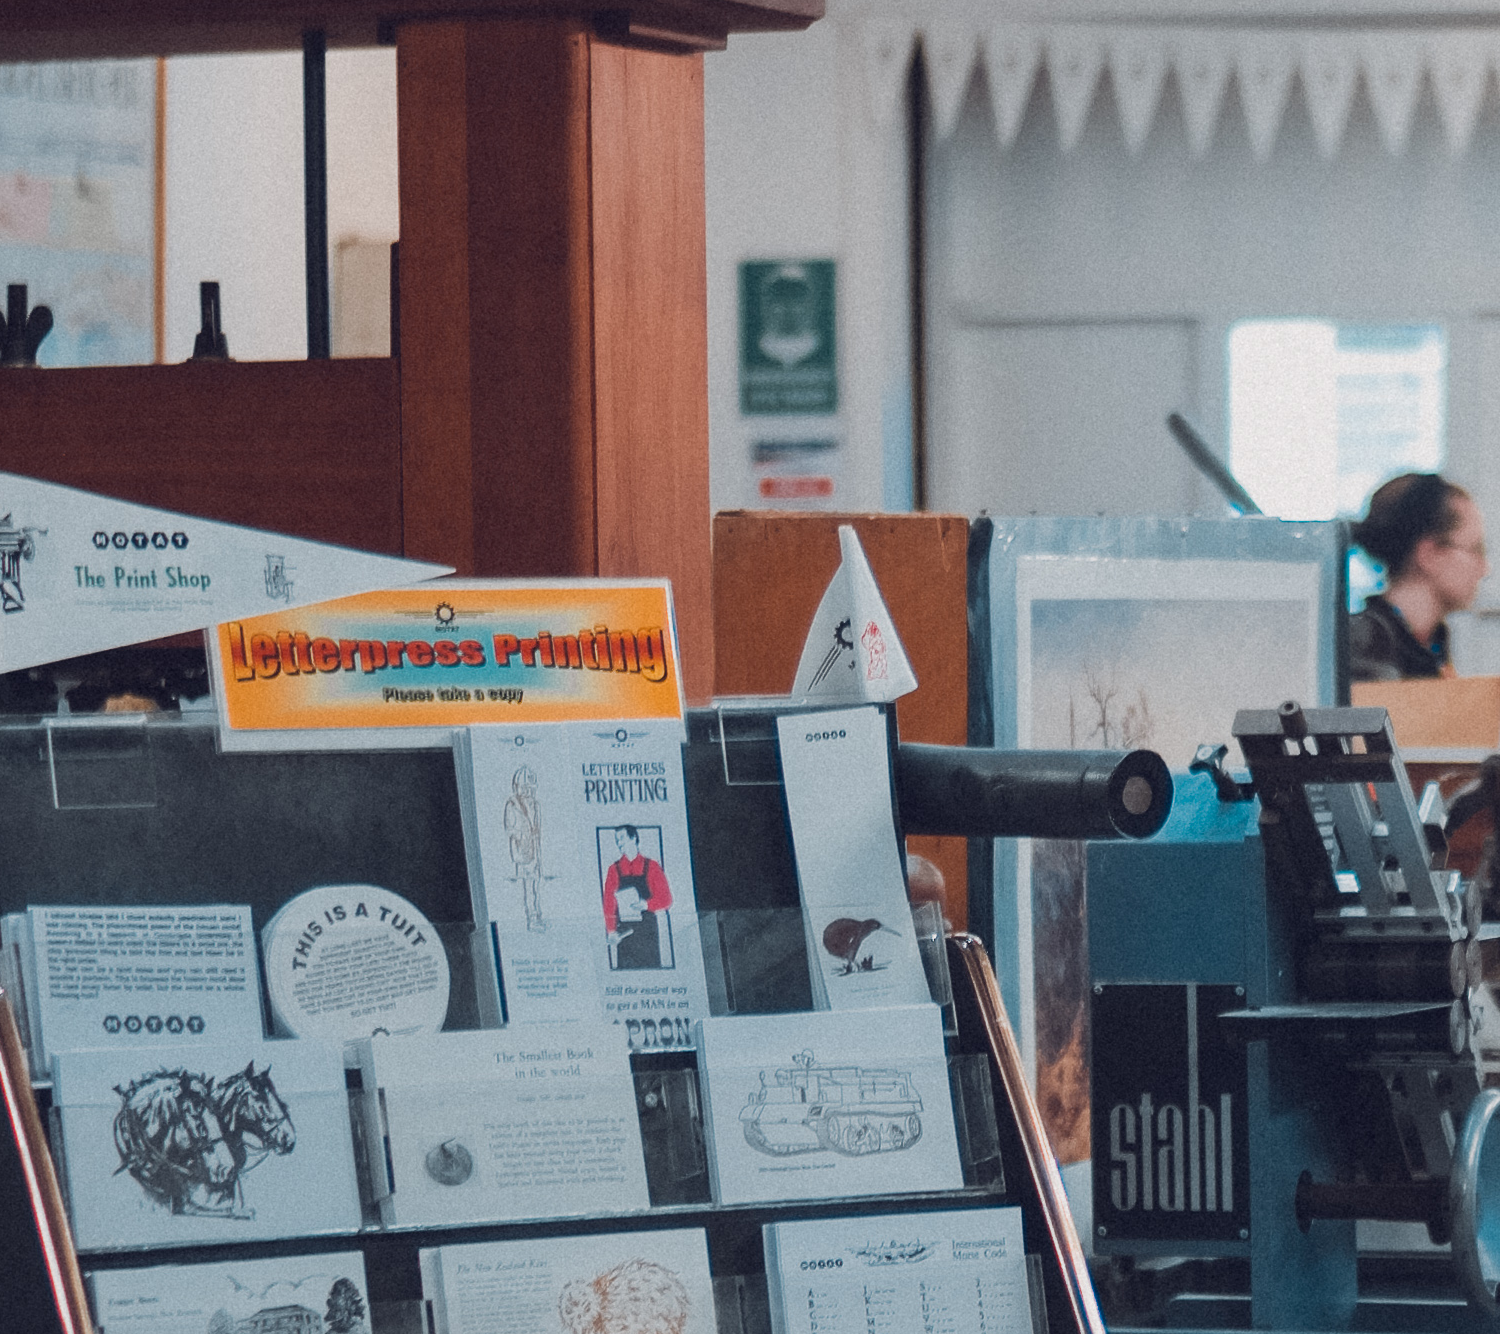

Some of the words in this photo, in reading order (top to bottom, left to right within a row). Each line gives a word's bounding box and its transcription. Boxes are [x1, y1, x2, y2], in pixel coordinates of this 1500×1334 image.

[92, 531, 189, 550] MOTAT
[73, 566, 106, 589] The
[113, 567, 158, 588] Print
[166, 566, 212, 592] Shop
[227, 621, 486, 682] Letterpress
[491, 624, 668, 682] Printing
[383, 686, 435, 703] Please
[437, 686, 472, 702] take
[474, 689, 484, 702] a
[487, 688, 524, 704] copy
[581, 762, 666, 778] LETTERPRESS
[584, 778, 669, 805] PRINTING
[293, 921, 323, 970] THIS
[324, 906, 346, 925] IS
[355, 902, 369, 917] A
[379, 906, 427, 946] TUIT
[640, 998, 665, 1010] MAN
[103, 1015, 205, 1034] MOTAT
[612, 1018, 693, 1048] PRON
[494, 1052, 515, 1064] The
[519, 1049, 562, 1062] Smallest
[566, 1048, 594, 1059] Book
[515, 1067, 526, 1079] in
[530, 1067, 546, 1078] the
[550, 1065, 581, 1076] world
[1109, 995, 1233, 1212] stahl
